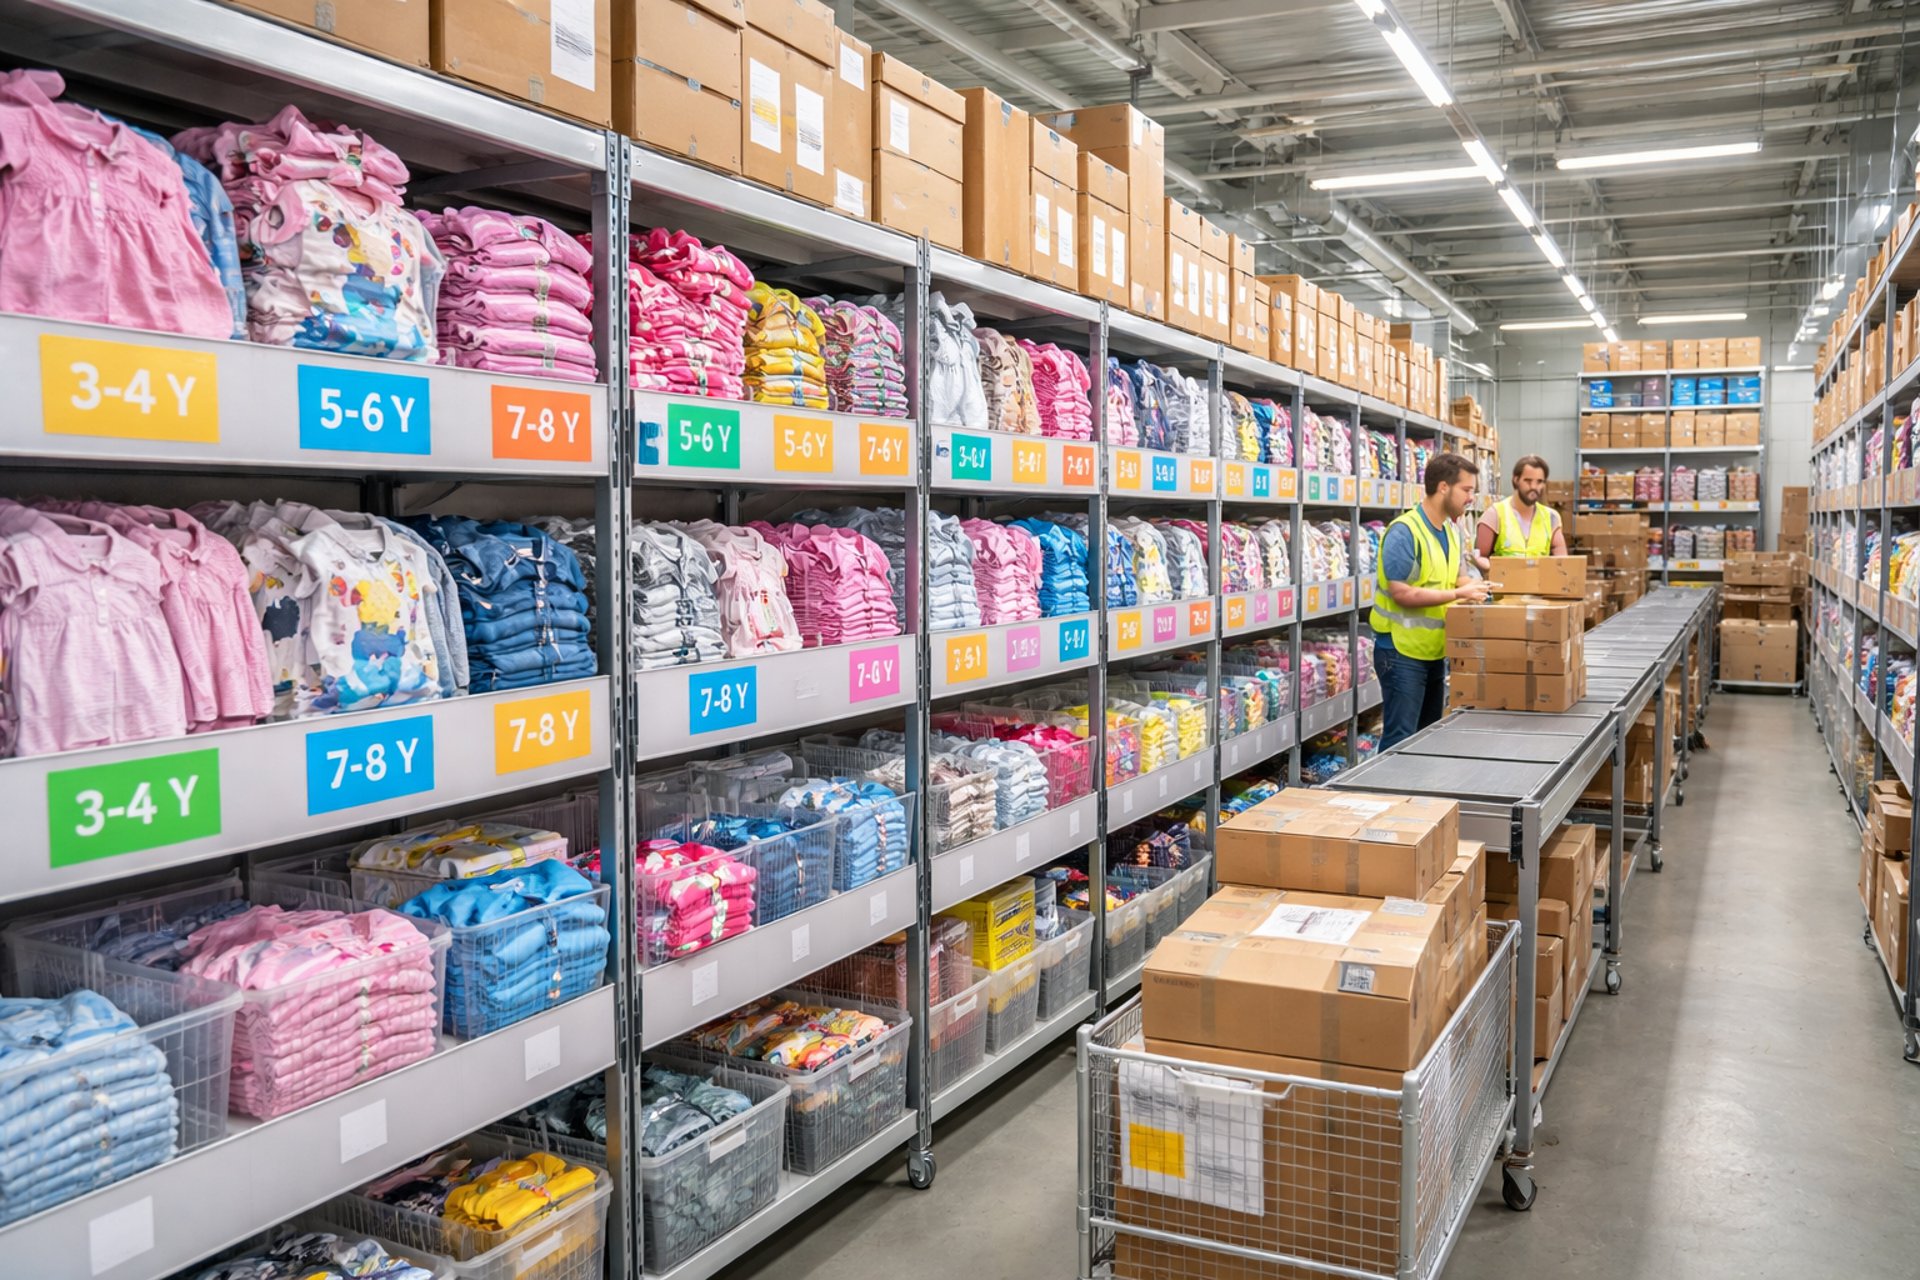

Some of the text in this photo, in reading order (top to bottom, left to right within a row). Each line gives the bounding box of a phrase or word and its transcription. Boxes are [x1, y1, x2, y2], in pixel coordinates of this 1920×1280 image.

[70, 361, 196, 417] 3-4 Y
[320, 387, 415, 433] 5-6 Y
[507, 404, 580, 443] 7-8 Y
[679, 419, 732, 453] 5-6 Y
[784, 429, 827, 458] 5-6 Y
[893, 438, 903, 462] Y
[883, 659, 893, 682] Y
[700, 682, 748, 717] 7-8 Y
[509, 709, 579, 753] 7-8 Y
[326, 737, 419, 789] 7-8 Y
[75, 774, 199, 837] 3-4 Y
